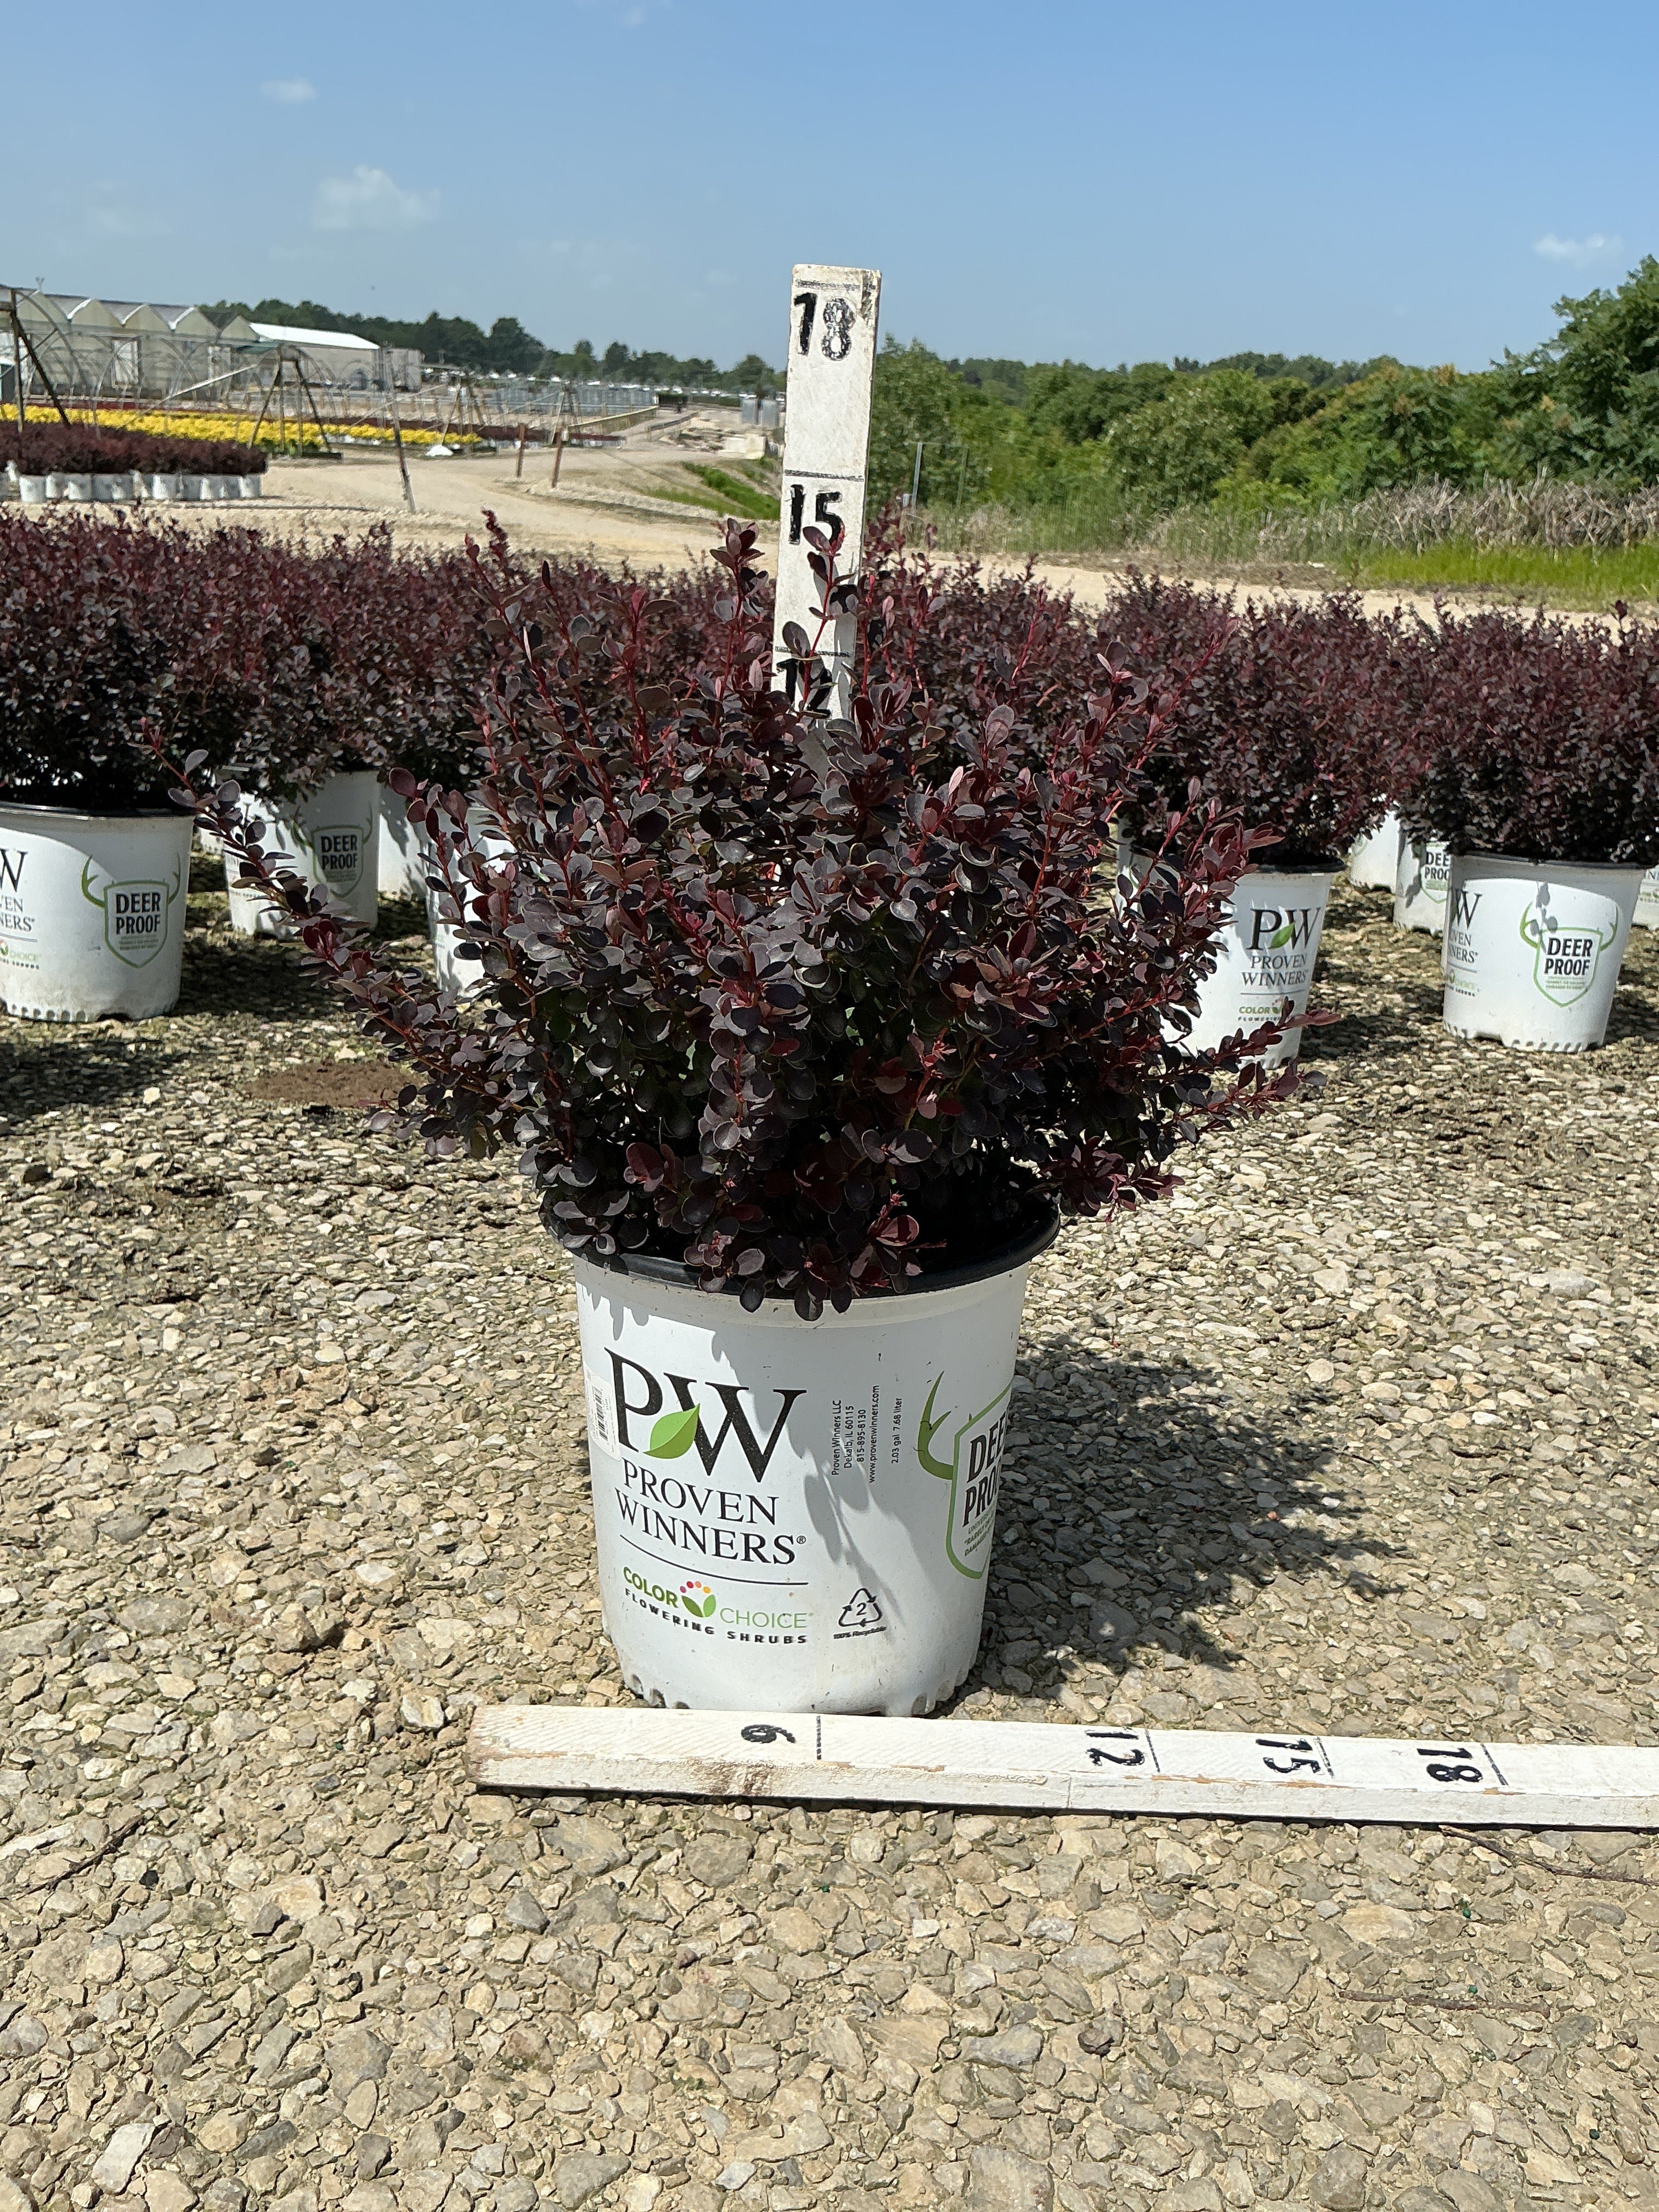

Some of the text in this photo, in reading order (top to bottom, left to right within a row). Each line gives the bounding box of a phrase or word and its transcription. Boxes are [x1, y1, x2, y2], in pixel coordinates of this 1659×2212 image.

[794, 292, 857, 361] 18
[788, 484, 845, 545] 15
[321, 834, 358, 853] DEER
[1426, 851, 1449, 867] DEE
[321, 854, 358, 870] PROOF
[1425, 867, 1449, 880] PRO
[115, 893, 161, 914] DEER
[115, 914, 161, 935] PROOF
[1246, 907, 1322, 950] PW
[1251, 953, 1307, 969] PROVEN
[1547, 936, 1593, 957] DEER
[1544, 958, 1591, 975] PROOF
[1238, 1006, 1271, 1014] COLOR
[604, 1346, 807, 1483] PW
[845, 1405, 854, 1430] 60115
[891, 1397, 902, 1464] 2.03 gal 7.68 liter
[831, 1400, 842, 1475] Proven Winners LLC
[856, 1409, 866, 1463] 815-895-8130
[869, 1385, 880, 1483] www.provenwinners.com
[967, 1410, 1007, 1483] DEE
[844, 1438, 854, 1469] Dekalb,
[621, 1457, 780, 1526] PROVEN
[623, 1566, 679, 1609] COLOR
[625, 1587, 808, 1645] FLOWERING SHRUBS
[856, 1602, 867, 1616] 2
[1084, 1729, 1146, 1767] 12
[1255, 1737, 1321, 1774] 15
[1417, 1746, 1483, 1782] 18
